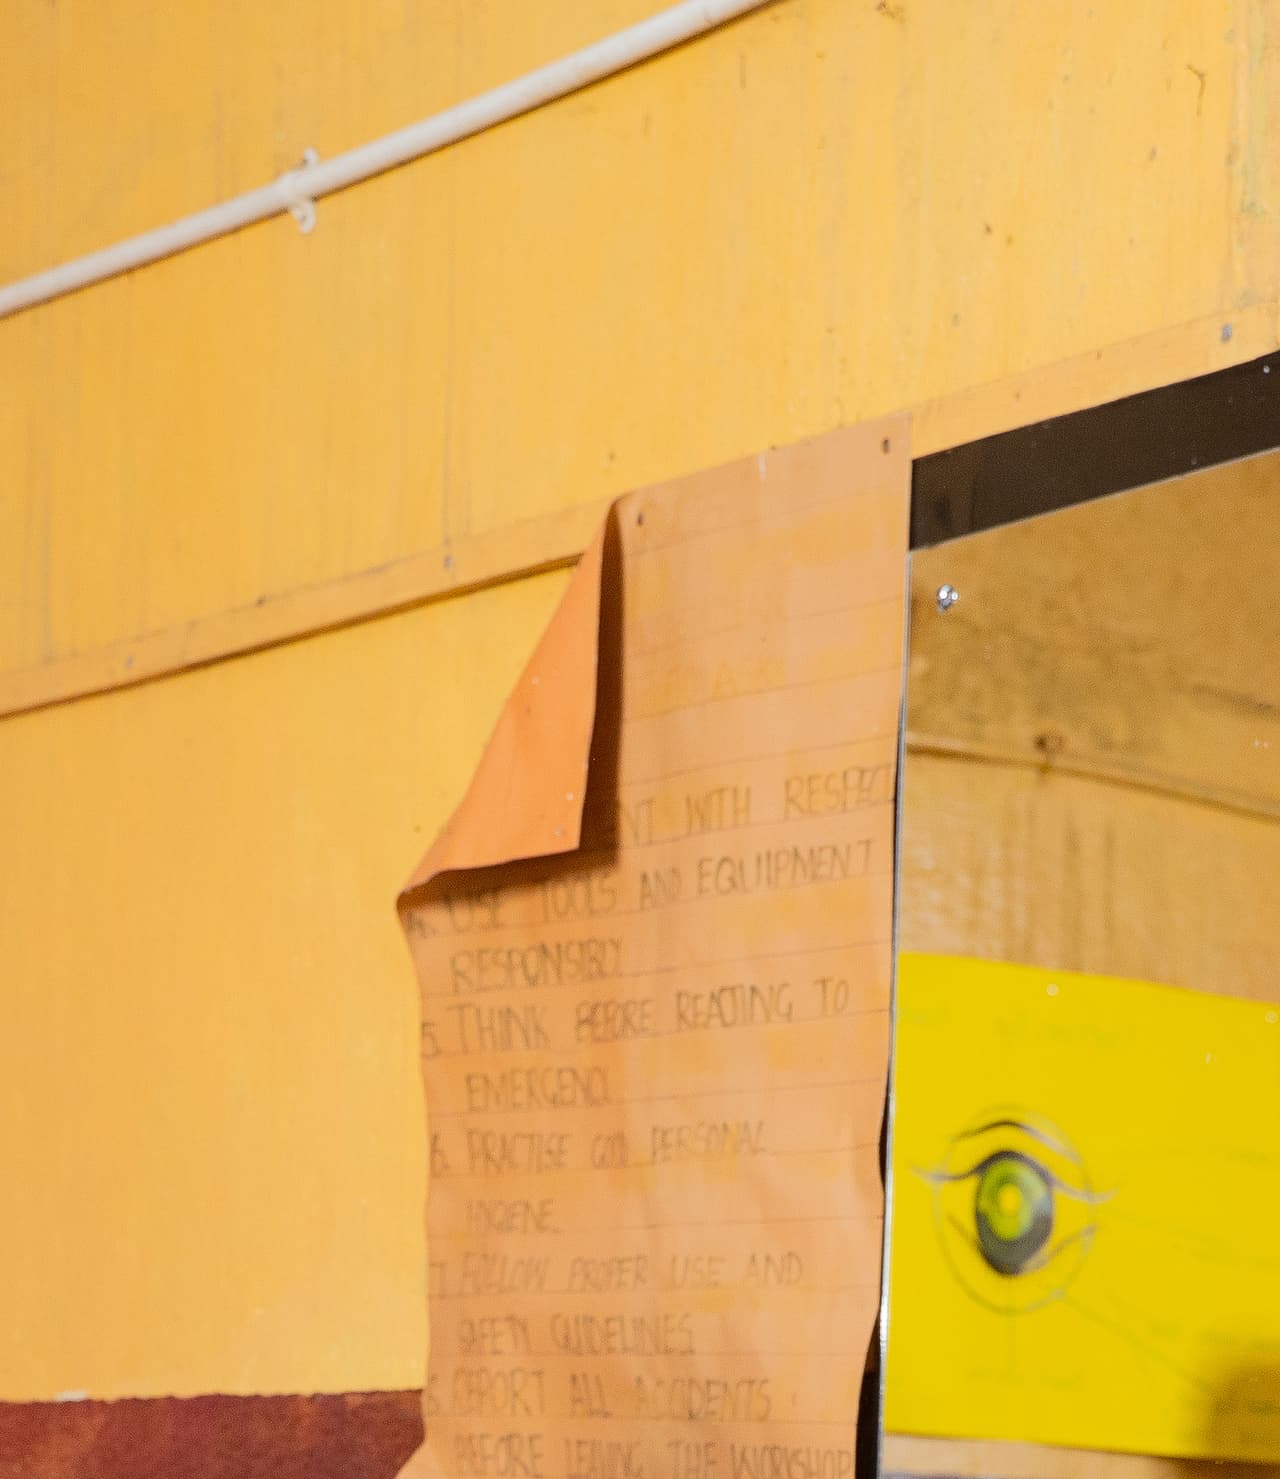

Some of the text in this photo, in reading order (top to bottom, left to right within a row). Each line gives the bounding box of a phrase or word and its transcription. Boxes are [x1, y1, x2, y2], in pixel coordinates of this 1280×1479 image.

[685, 786, 752, 837] WITH
[540, 877, 617, 924] TOOLS
[639, 864, 682, 912] AND
[696, 838, 877, 897] EQUIPMENT
[446, 1001, 552, 1055] THINK
[573, 998, 655, 1044] BEFORE
[812, 975, 851, 1017] TO
[464, 1063, 611, 1112] EMERGENCY
[466, 1128, 571, 1177] PRACTISE
[650, 1118, 770, 1166] PERSONAL
[459, 1252, 550, 1297] FOLLOW
[567, 1253, 649, 1292] PROPER
[670, 1253, 727, 1289] USE
[743, 1251, 804, 1288] AND
[550, 1312, 697, 1358] GUIDELINES
[569, 1373, 612, 1419] ALL
[634, 1375, 773, 1423] ACCIDENTS
